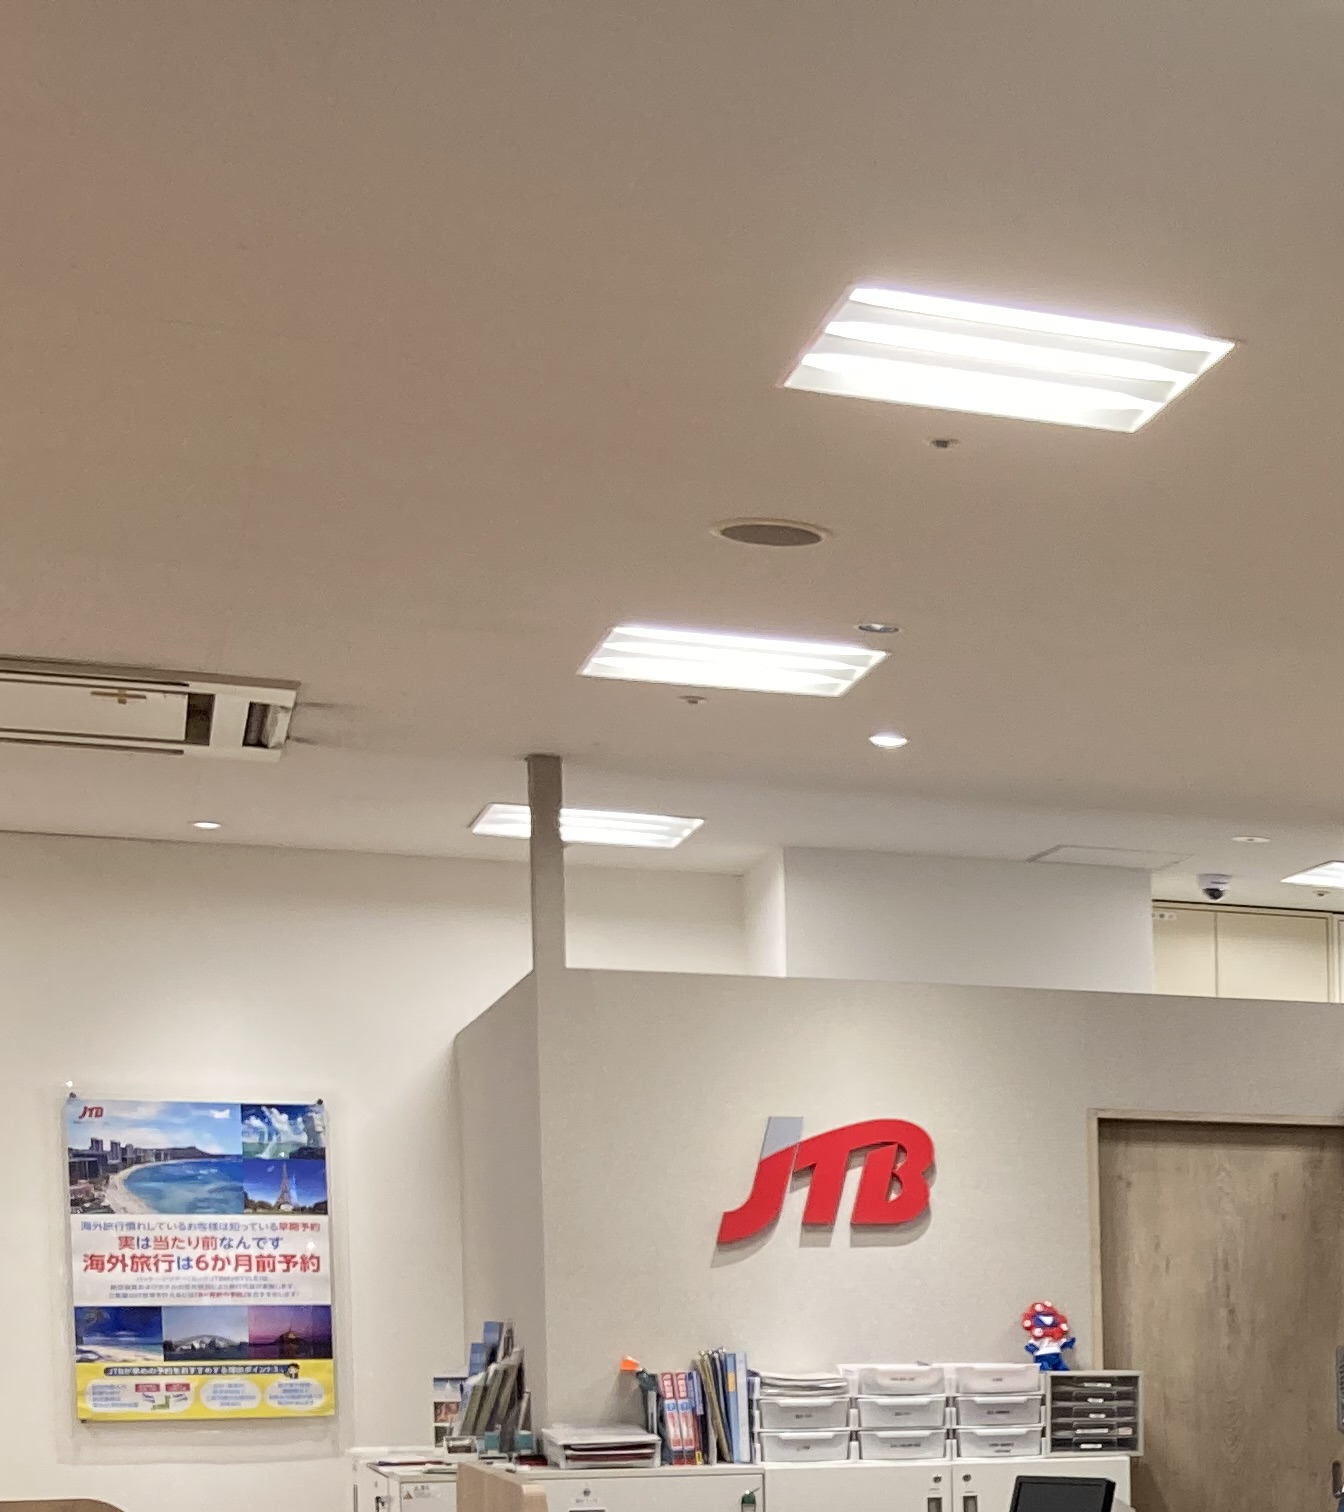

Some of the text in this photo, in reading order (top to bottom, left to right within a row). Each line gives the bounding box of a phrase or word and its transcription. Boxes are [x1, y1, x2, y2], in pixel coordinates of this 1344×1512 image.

[718, 1116, 935, 1243] JTB
[118, 1236, 284, 1250] 実は当たり前なんです
[83, 1254, 321, 1273] 海外旅行は6か月前予約
